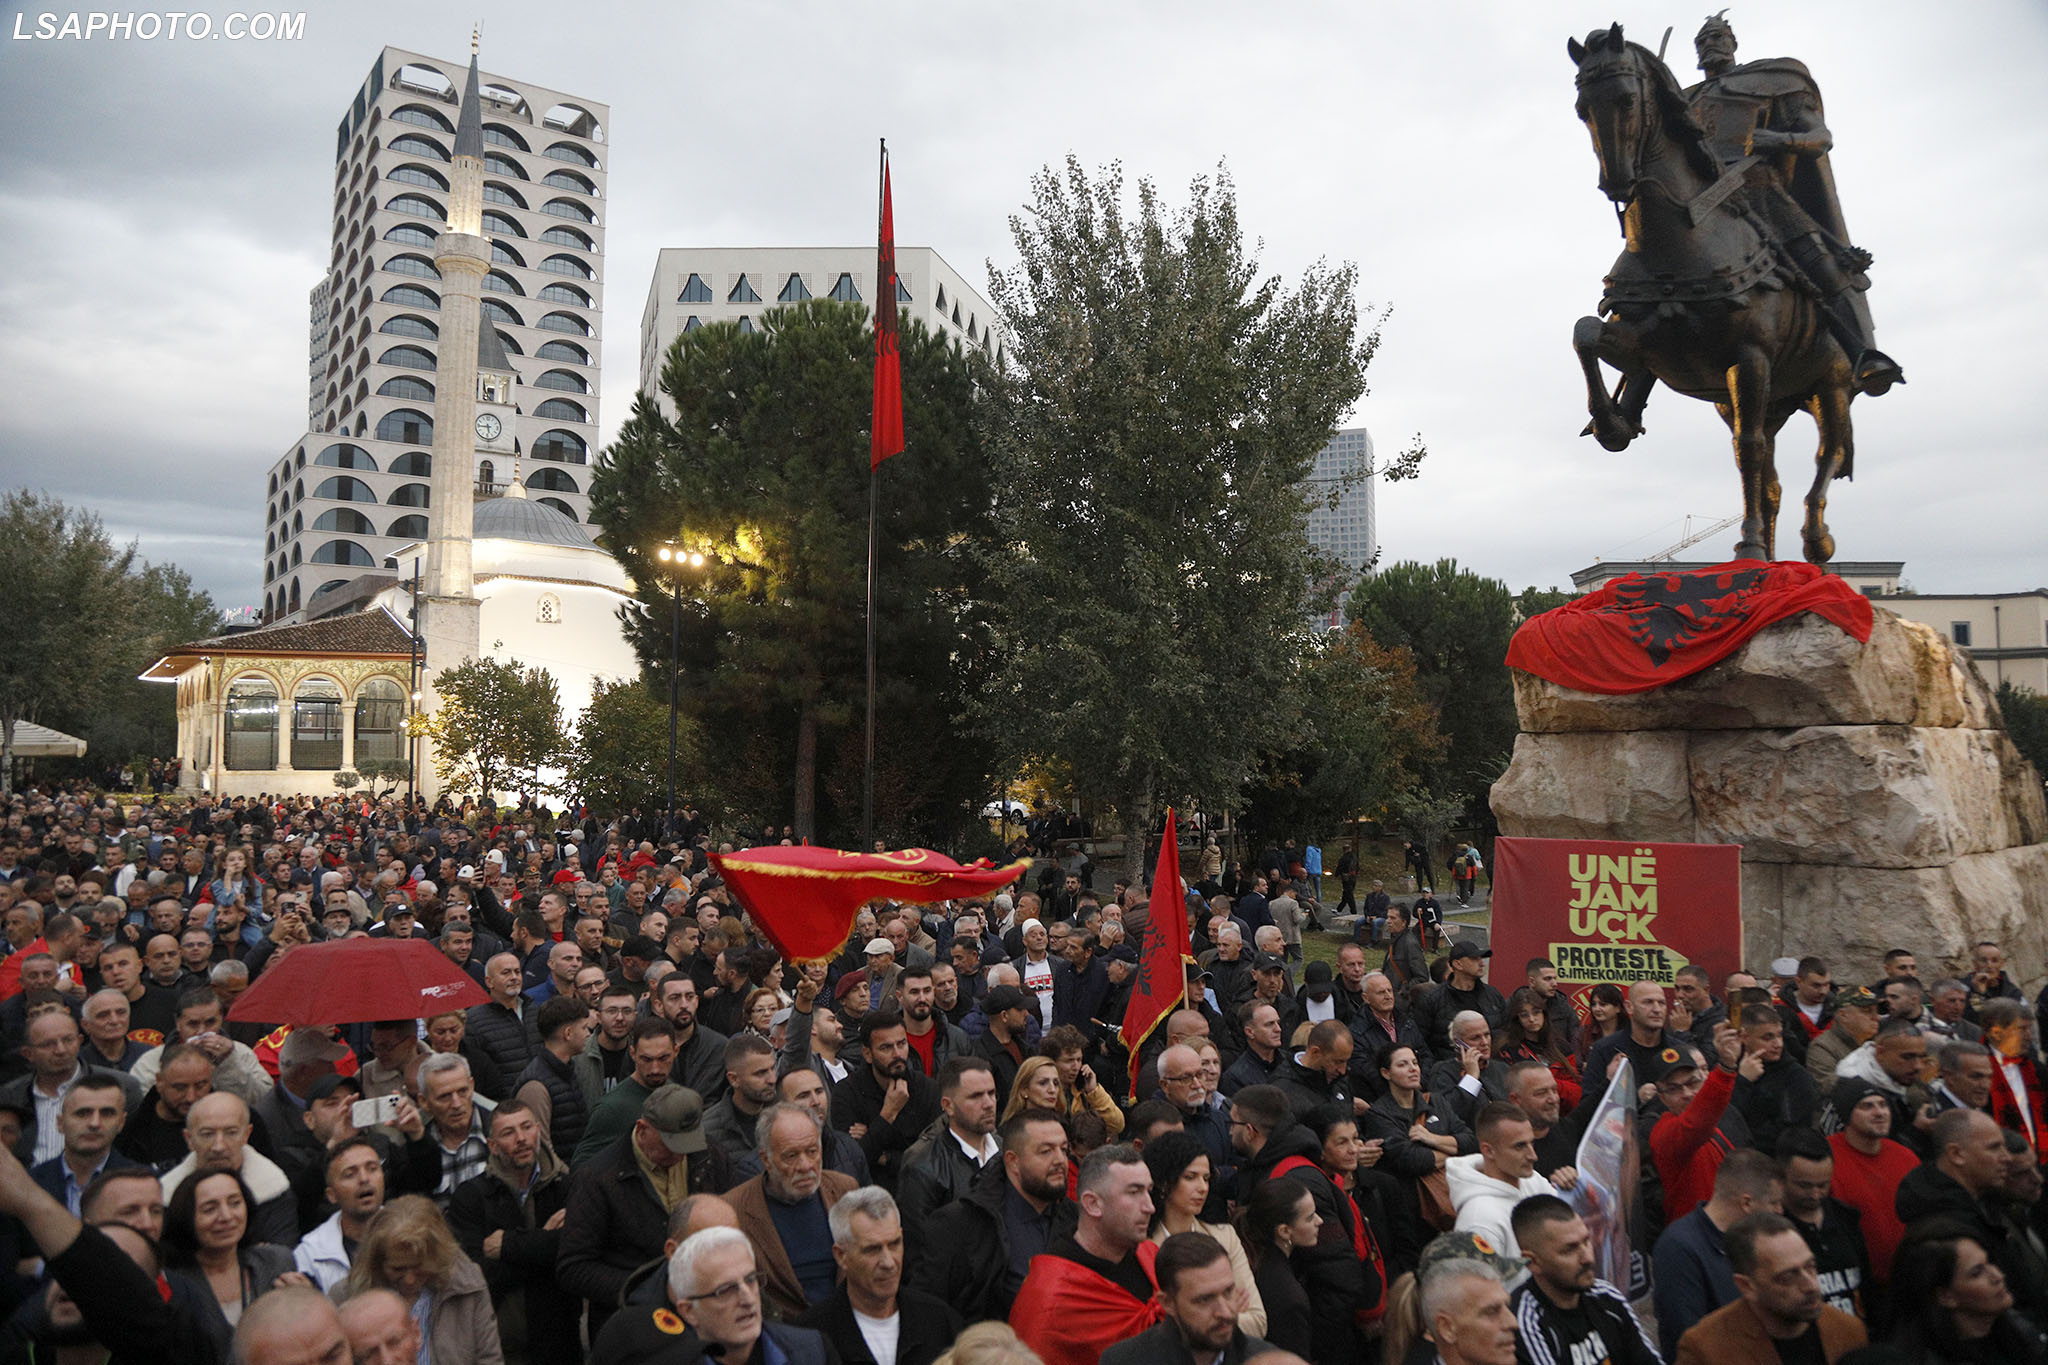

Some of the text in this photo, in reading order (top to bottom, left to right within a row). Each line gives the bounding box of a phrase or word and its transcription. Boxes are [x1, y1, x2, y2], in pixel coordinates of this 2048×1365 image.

[1568, 847, 1657, 885] UNË
[1568, 881, 1658, 914] JAM
[1568, 908, 1657, 944] UÇK
[1557, 946, 1672, 970] PROTESTE
